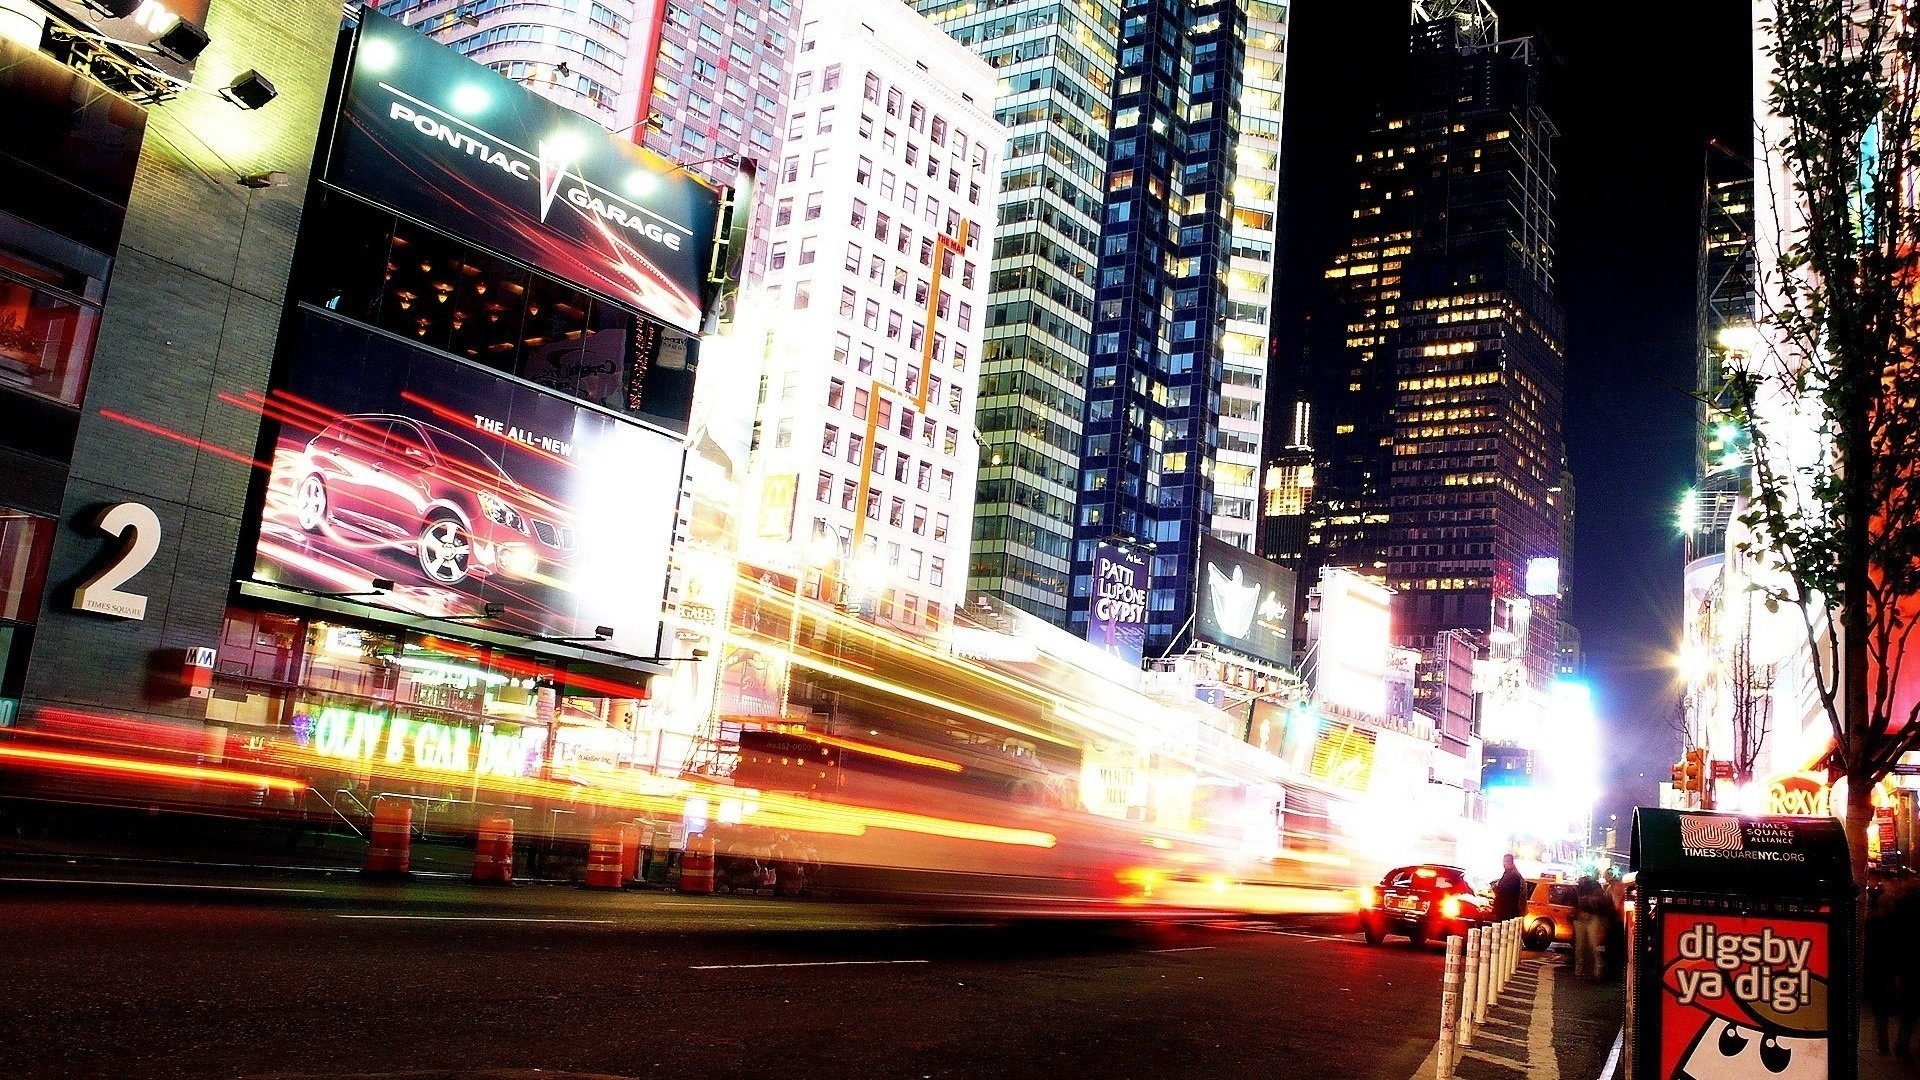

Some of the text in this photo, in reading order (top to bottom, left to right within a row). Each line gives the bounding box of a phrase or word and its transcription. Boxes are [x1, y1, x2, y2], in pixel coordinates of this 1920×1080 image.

[389, 101, 682, 251] PONTIAC GARAGE
[474, 414, 574, 457] THE ALL-NEW
[80, 502, 161, 620] 2
[1099, 557, 1135, 587] PATTI
[87, 600, 142, 616] TIMES SQUARE
[1095, 597, 1146, 624] GYPSY
[1746, 829, 1795, 837] SQUARE
[1750, 822, 1789, 830] TIMES
[1682, 847, 1805, 862] TIMESSQUARENYC.ORG
[1750, 836, 1793, 845] ALLIANCE
[1680, 924, 1810, 972] digsby
[1677, 966, 1809, 1012] ya dig!
